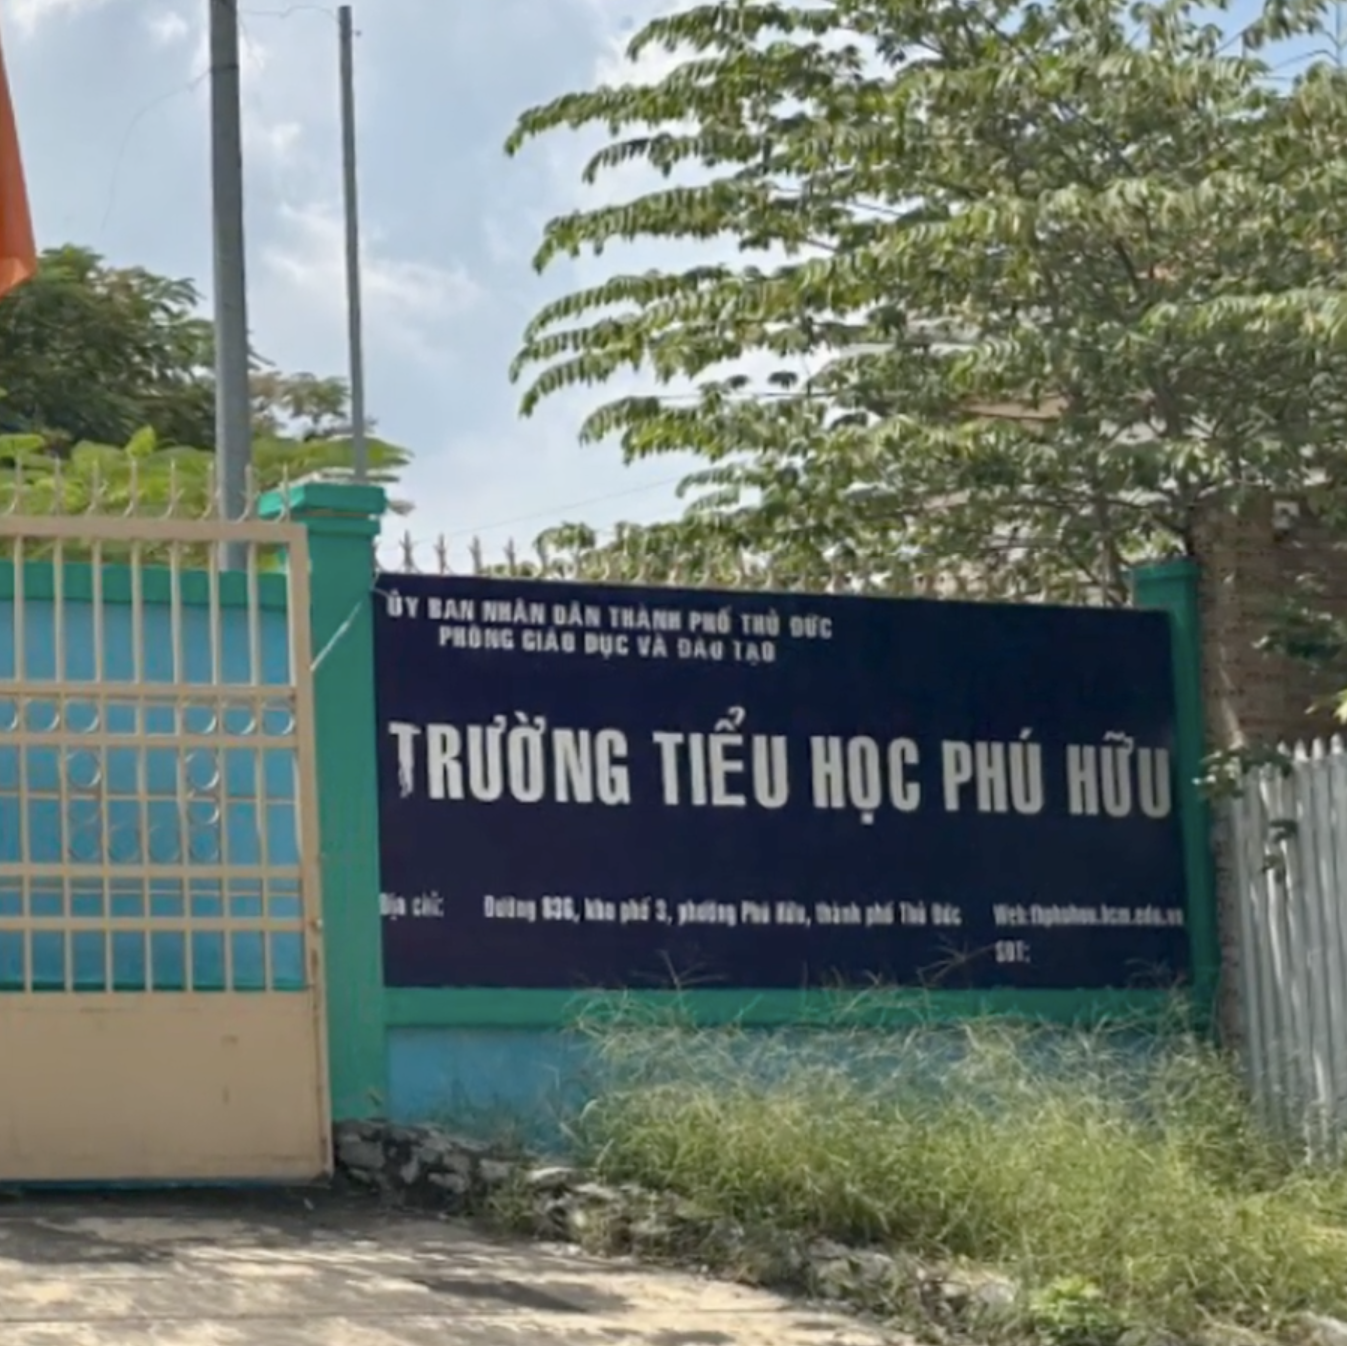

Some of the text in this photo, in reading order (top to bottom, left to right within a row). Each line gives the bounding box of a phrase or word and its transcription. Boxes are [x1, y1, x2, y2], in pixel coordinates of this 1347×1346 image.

[386, 588, 833, 639] ỦY BAN NHÂN DÂN THÀNH PHỐ THỦ ĐỨC
[439, 624, 514, 649] PHÒNG
[584, 633, 629, 660] DỤC
[637, 633, 668, 658] VÀ
[733, 640, 775, 666] TẠO
[388, 706, 1171, 825] TRƯỜNG TIỂU HỌC PHÚ HỮU
[655, 899, 672, 926] 3,
